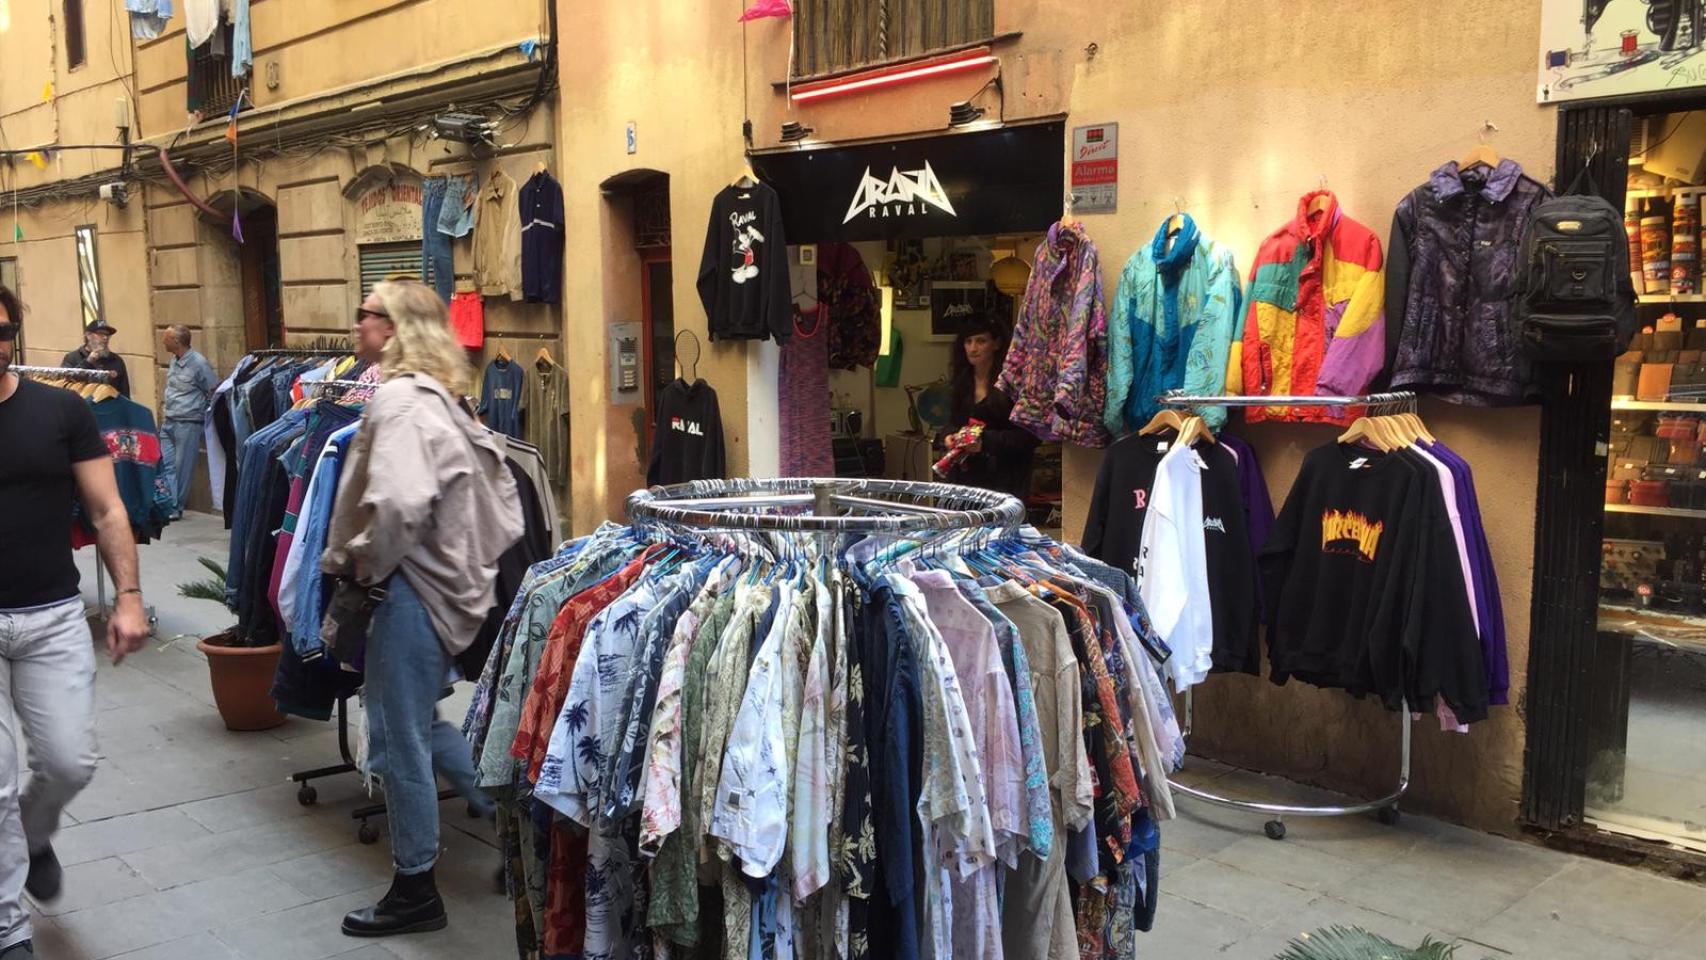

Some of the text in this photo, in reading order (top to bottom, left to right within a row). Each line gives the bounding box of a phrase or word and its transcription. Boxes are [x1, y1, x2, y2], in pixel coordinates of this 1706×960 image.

[1074, 164, 1116, 178] Alarma
[869, 203, 928, 218] RAVAL
[671, 416, 704, 436] RAAL
